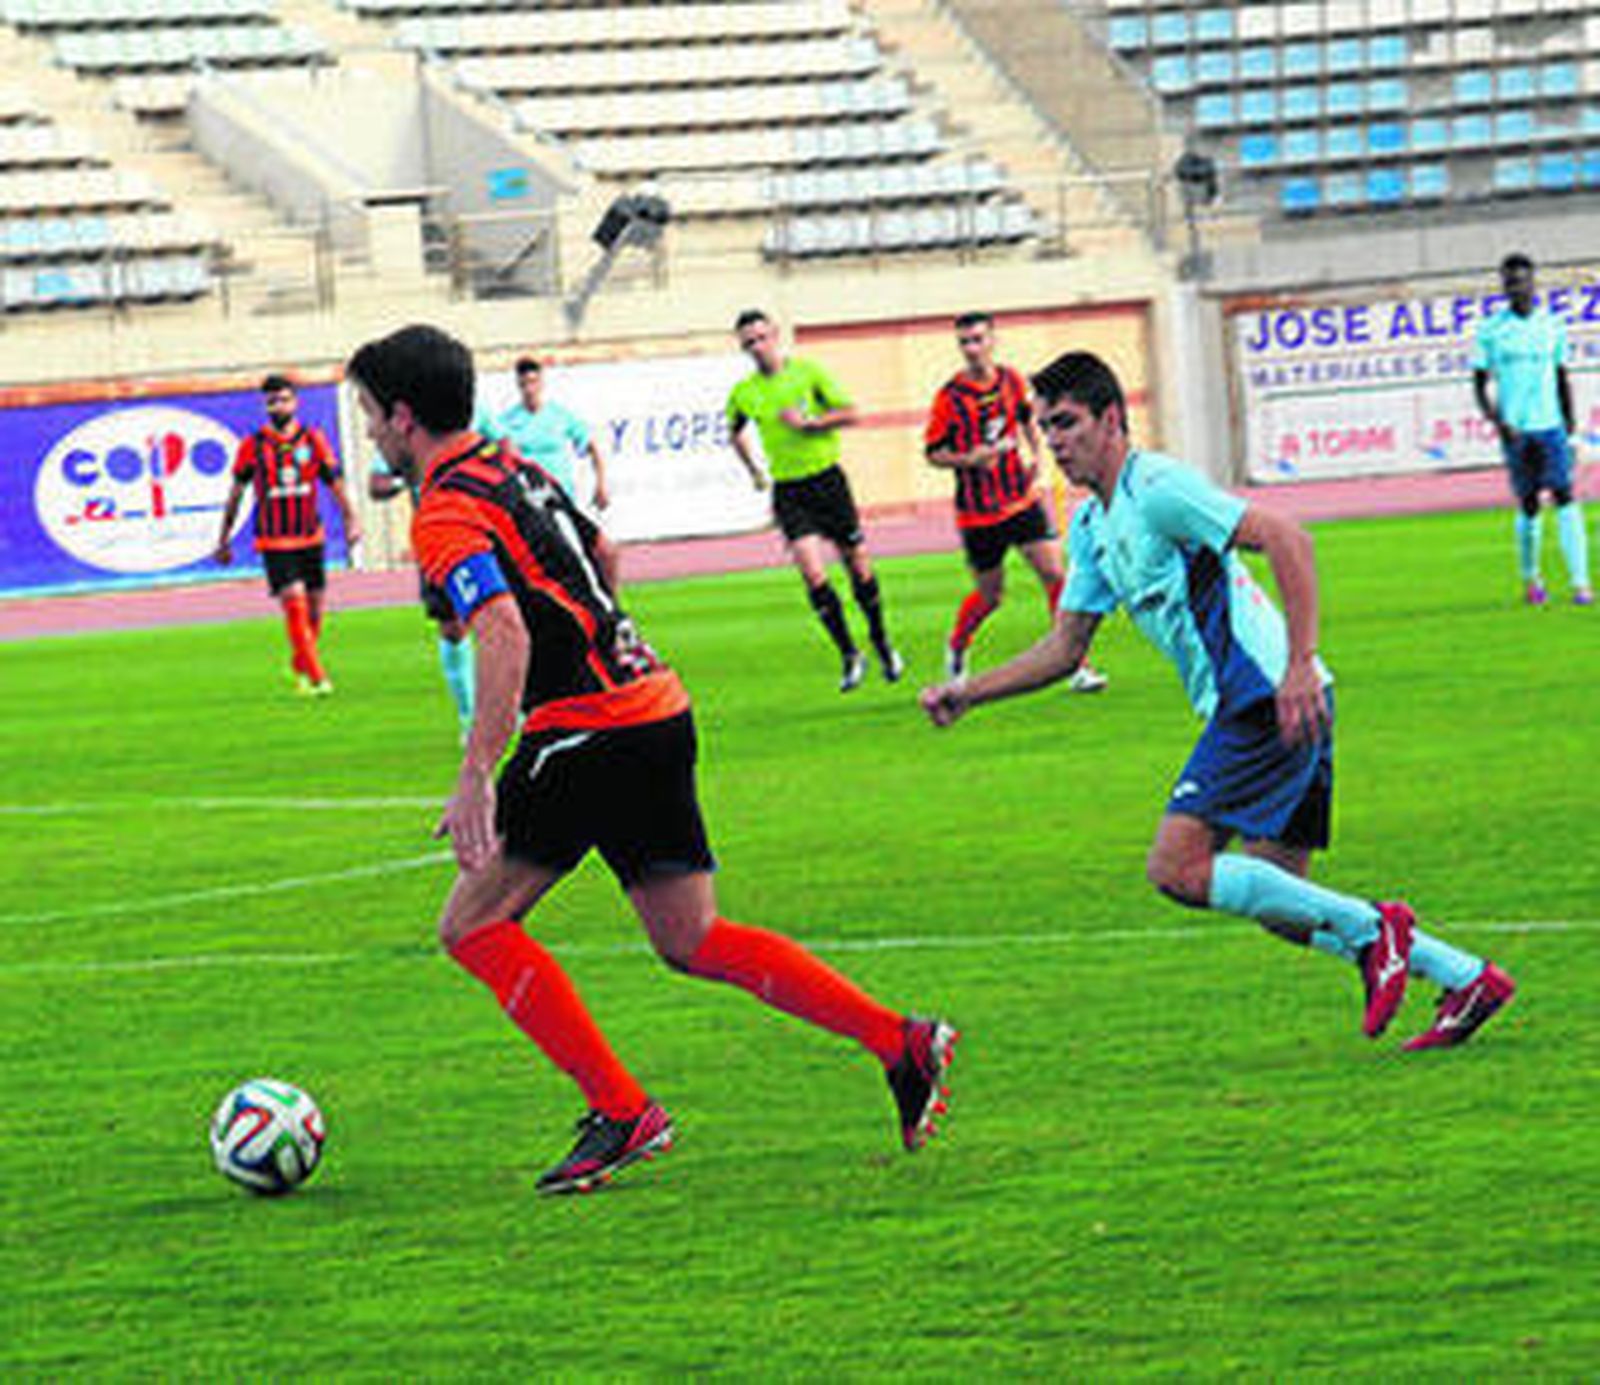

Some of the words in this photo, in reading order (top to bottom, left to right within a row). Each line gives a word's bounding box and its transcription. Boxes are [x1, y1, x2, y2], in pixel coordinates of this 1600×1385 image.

[1247, 304, 1371, 352] JOSE
[1387, 284, 1600, 340] ALFEEZ
[1252, 355, 1426, 386] MATERIALES
[610, 417, 629, 453] Y
